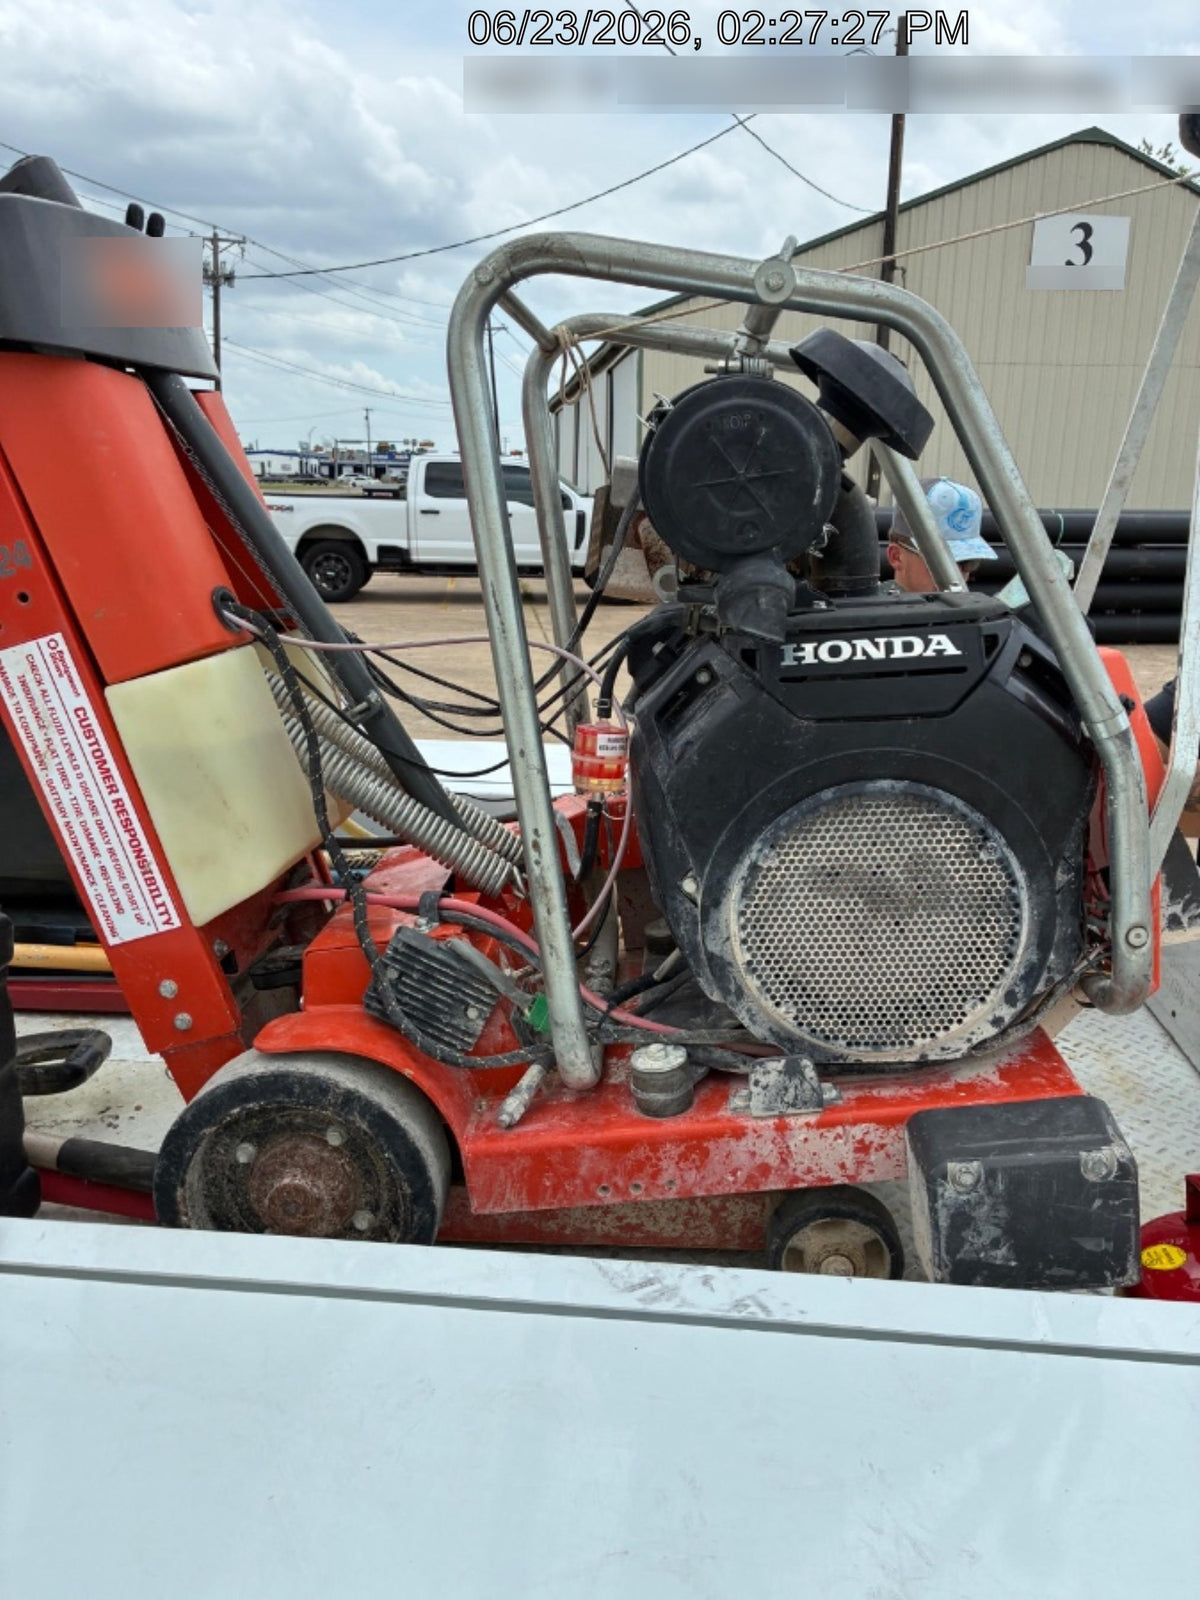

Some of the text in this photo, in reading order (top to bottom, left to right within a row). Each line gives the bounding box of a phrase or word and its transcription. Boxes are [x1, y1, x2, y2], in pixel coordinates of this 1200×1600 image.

[1064, 221, 1094, 266] 3
[780, 634, 963, 667] HONDA
[13, 701, 22, 713] TO
[19, 715, 48, 771] EQUIPMENT
[46, 778, 67, 818] BATTERY
[64, 820, 97, 886] MAINTENANCE
[95, 893, 119, 937] CLEANING
[18, 674, 124, 914] INSURANCE FLAT TIRES TIRE DAMAGE REFUELING
[26, 654, 44, 685] CHECK
[41, 688, 52, 705] ALL
[48, 707, 65, 735] FLUID
[61, 737, 80, 769] LEVELS
[80, 781, 99, 816] GREASE
[96, 819, 111, 844] DAILY
[107, 847, 126, 879] BEFORE
[122, 883, 138, 909] START
[135, 913, 144, 925] UP
[74, 707, 173, 926] CUSTOMER RESPONSIBILITY
